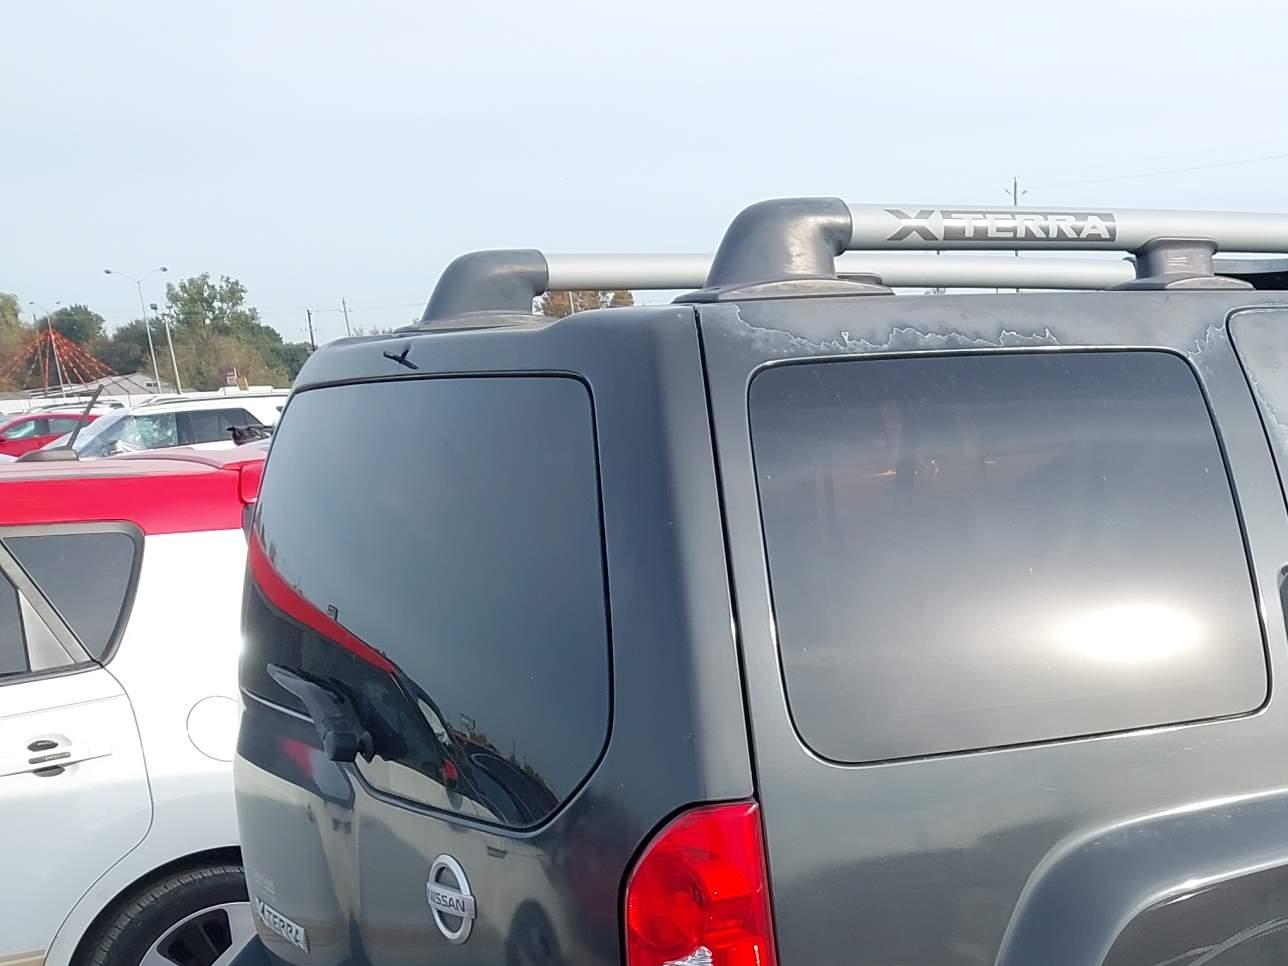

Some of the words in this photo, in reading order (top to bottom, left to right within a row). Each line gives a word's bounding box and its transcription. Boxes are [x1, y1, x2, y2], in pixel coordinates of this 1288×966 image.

[883, 208, 1115, 241] XTERRA
[426, 887, 466, 913] NISSAN
[254, 896, 311, 954] XTERRA
